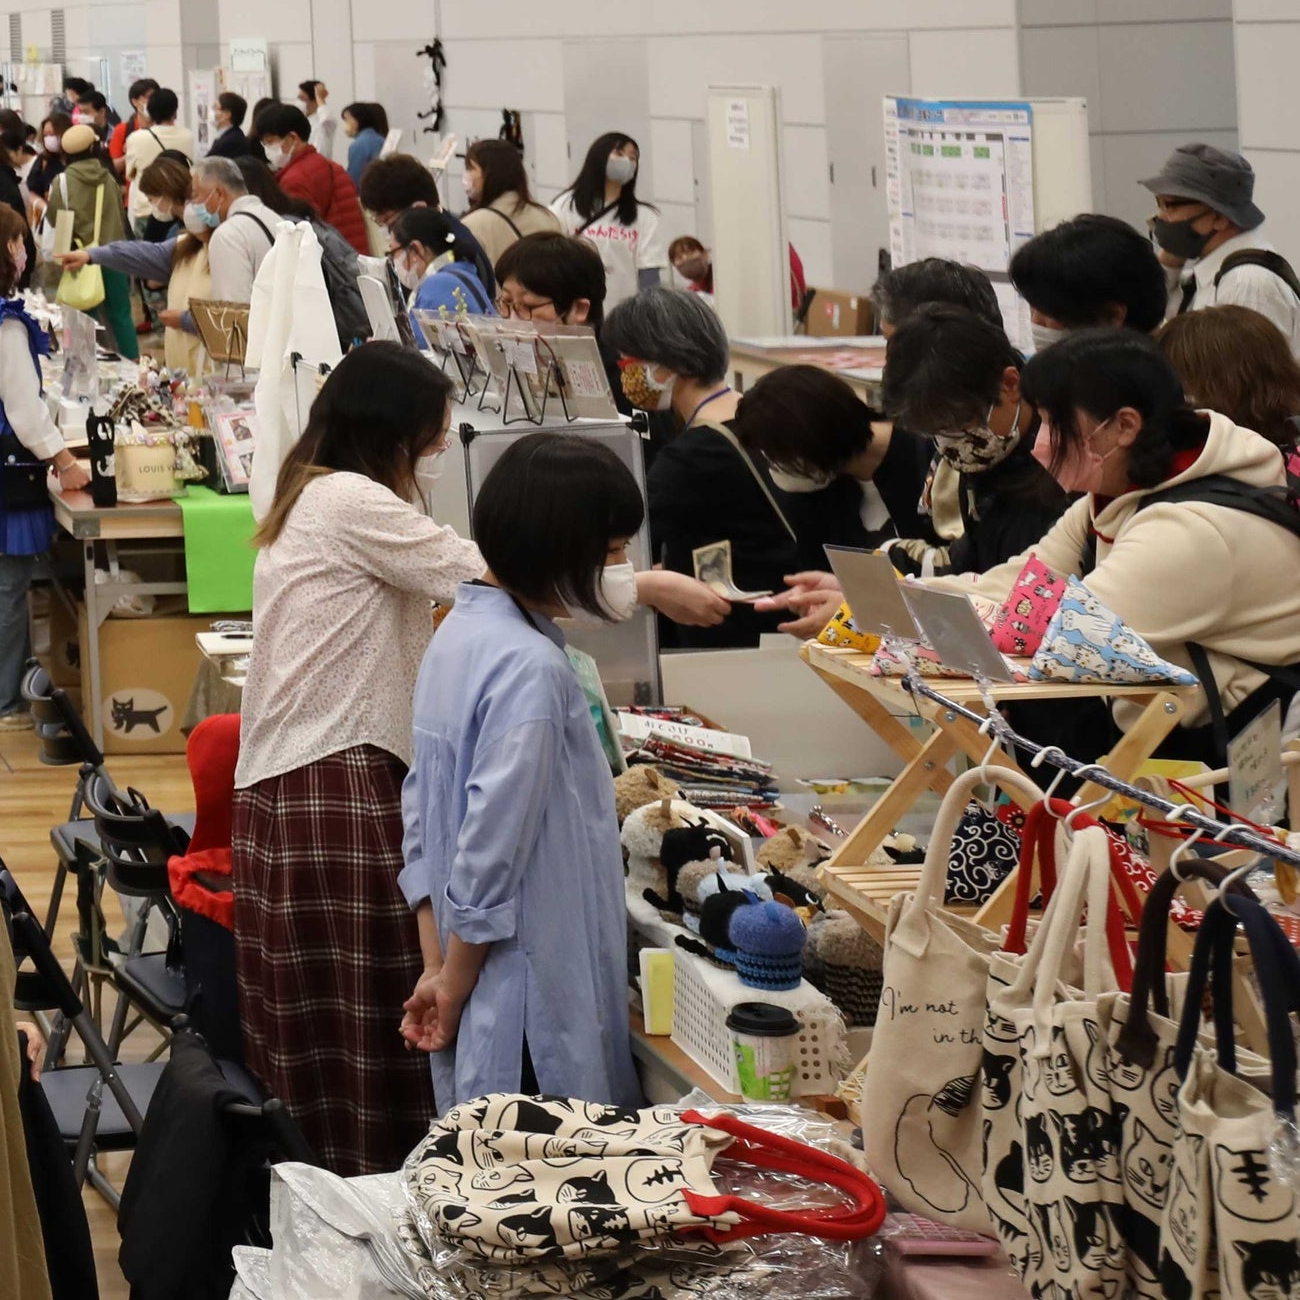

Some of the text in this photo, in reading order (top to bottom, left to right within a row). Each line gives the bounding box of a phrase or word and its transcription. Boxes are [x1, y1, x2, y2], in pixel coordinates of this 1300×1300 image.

[139, 465, 165, 474] LOUIS
[882, 986, 960, 1021] I'm not
[933, 1027, 955, 1044] in
